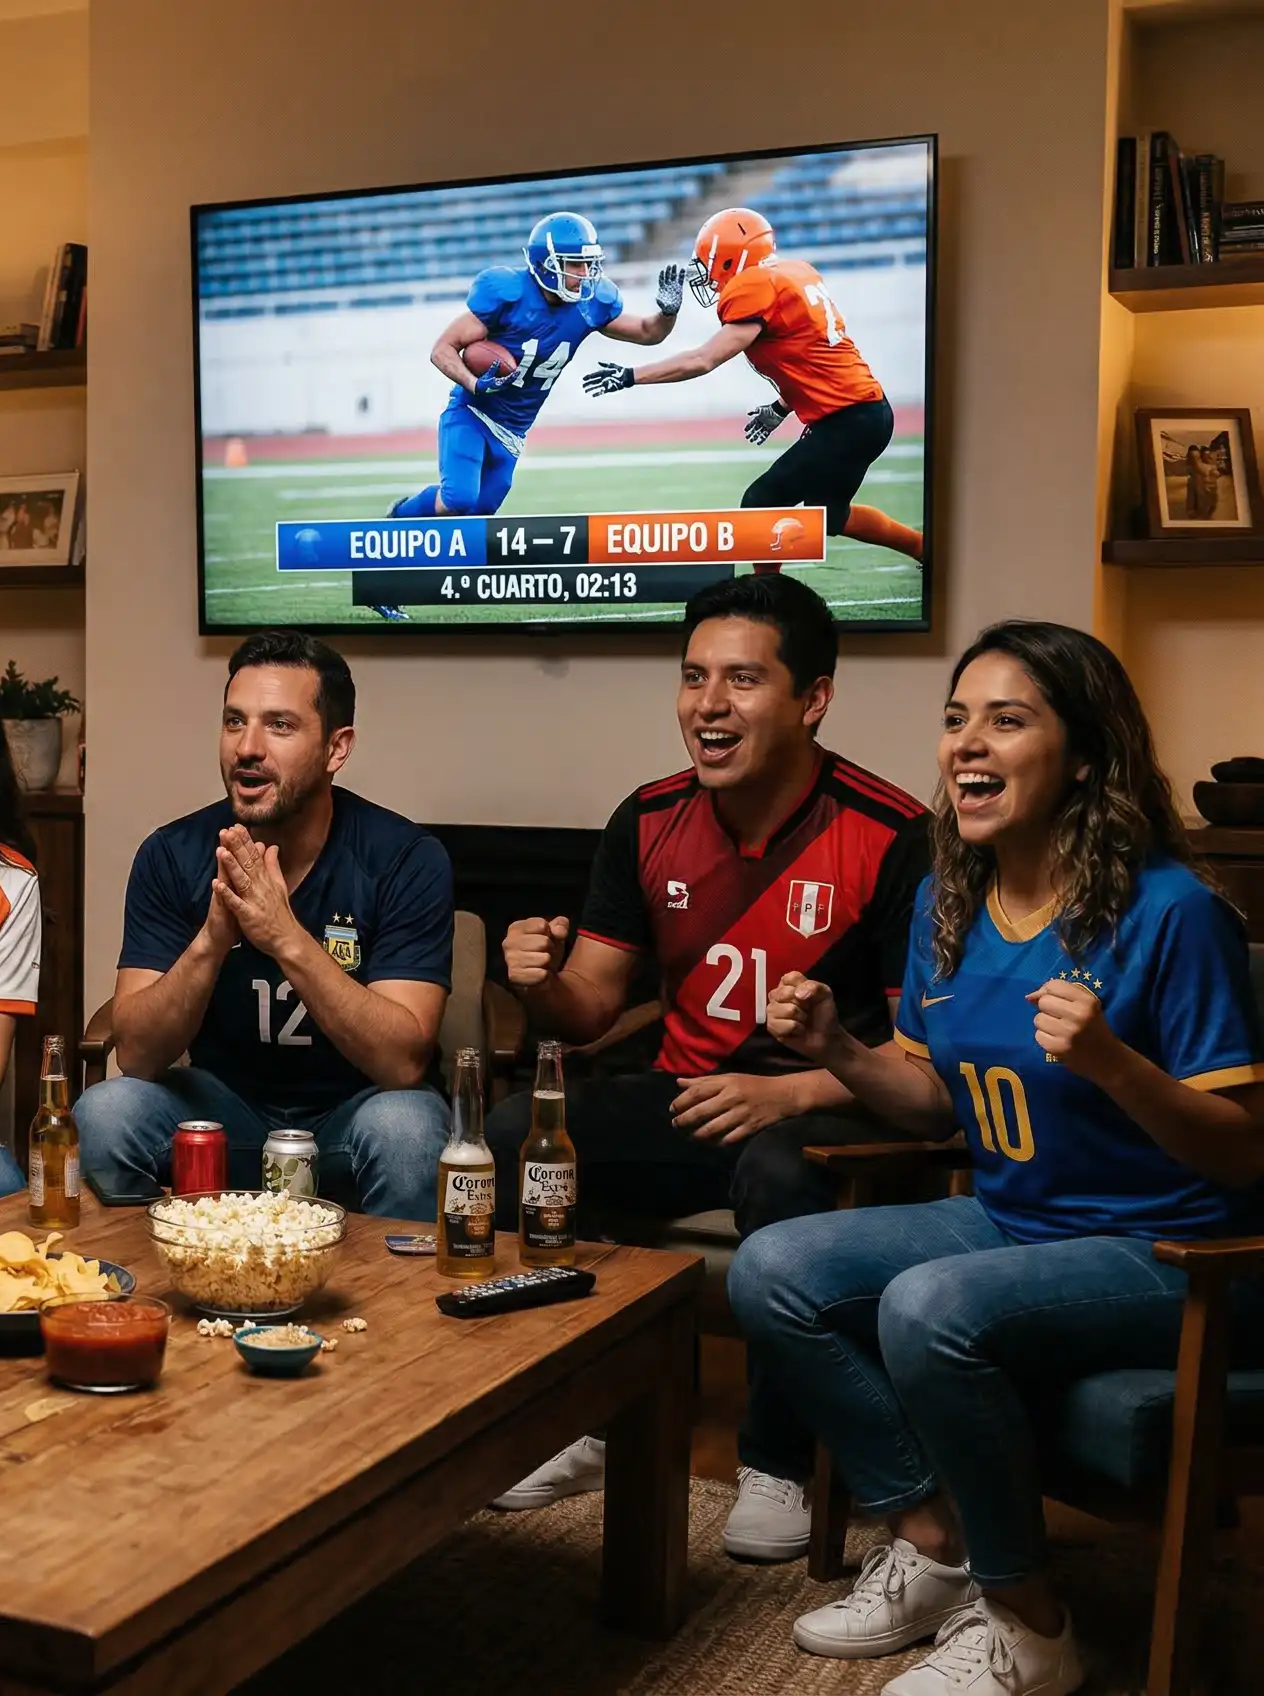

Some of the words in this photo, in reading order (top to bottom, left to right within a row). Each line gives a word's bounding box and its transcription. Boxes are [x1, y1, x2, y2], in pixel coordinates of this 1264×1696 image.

[512, 338, 571, 391] 14
[349, 529, 441, 560] EQUIPO
[448, 529, 467, 557] A
[496, 527, 527, 556] 14
[559, 525, 577, 555] 7
[607, 521, 708, 555] EQUIPO
[717, 521, 735, 552] B
[477, 573, 570, 602] CUARTO,
[576, 572, 637, 598] 02:13
[804, 903, 812, 912] P
[705, 943, 767, 1025] 21
[252, 978, 313, 1046] 12
[959, 1061, 1035, 1162] 10
